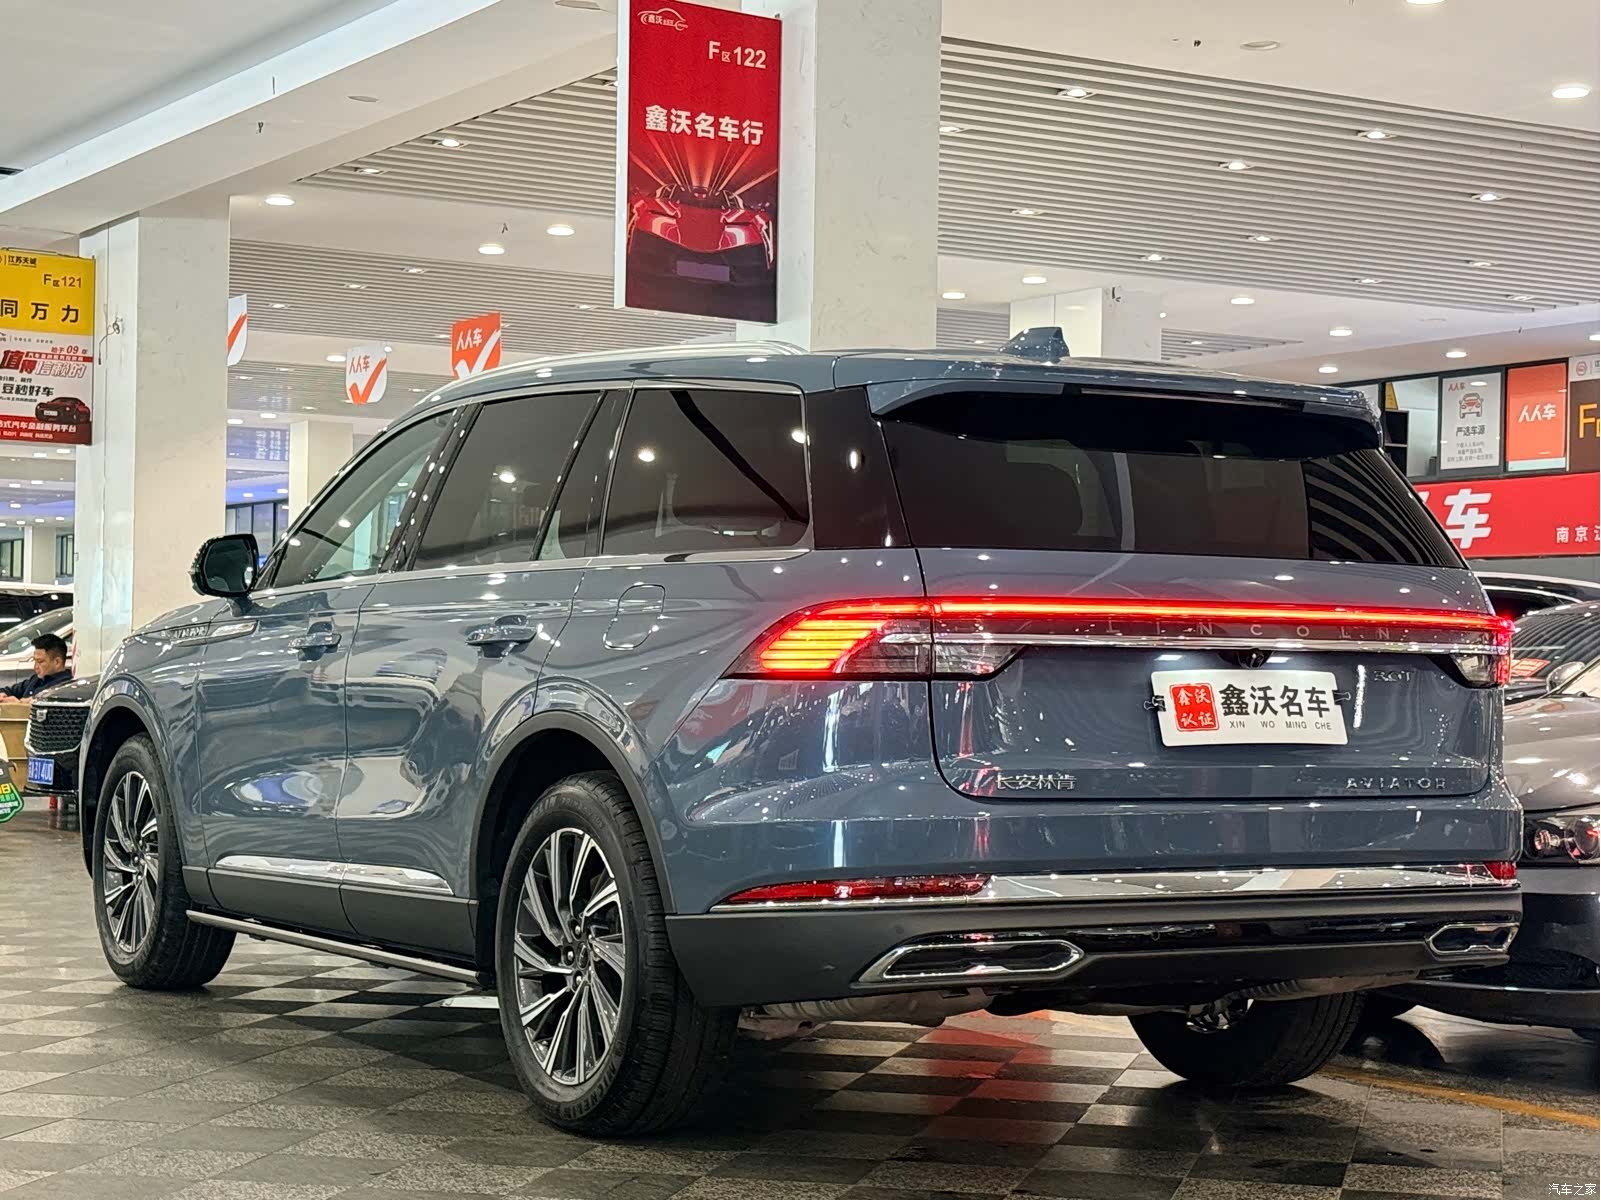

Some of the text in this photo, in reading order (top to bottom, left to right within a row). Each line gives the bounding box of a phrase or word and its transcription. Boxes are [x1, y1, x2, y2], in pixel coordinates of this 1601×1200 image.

[708, 40, 767, 69] F区122
[645, 104, 764, 146] 鑫沃名车行
[43, 273, 82, 288] F区121
[0, 299, 79, 323] 同万力
[456, 327, 482, 351] 人人车
[350, 355, 370, 374] 人人车
[1518, 403, 1557, 423] 人人车
[1105, 618, 1390, 640] LINCOLN
[1218, 684, 1330, 718] 鑫沃名车
[1229, 720, 1332, 731] XIN WO MING CHE
[996, 772, 1077, 790] 长安林肯
[1345, 777, 1447, 789] AVIATOR
